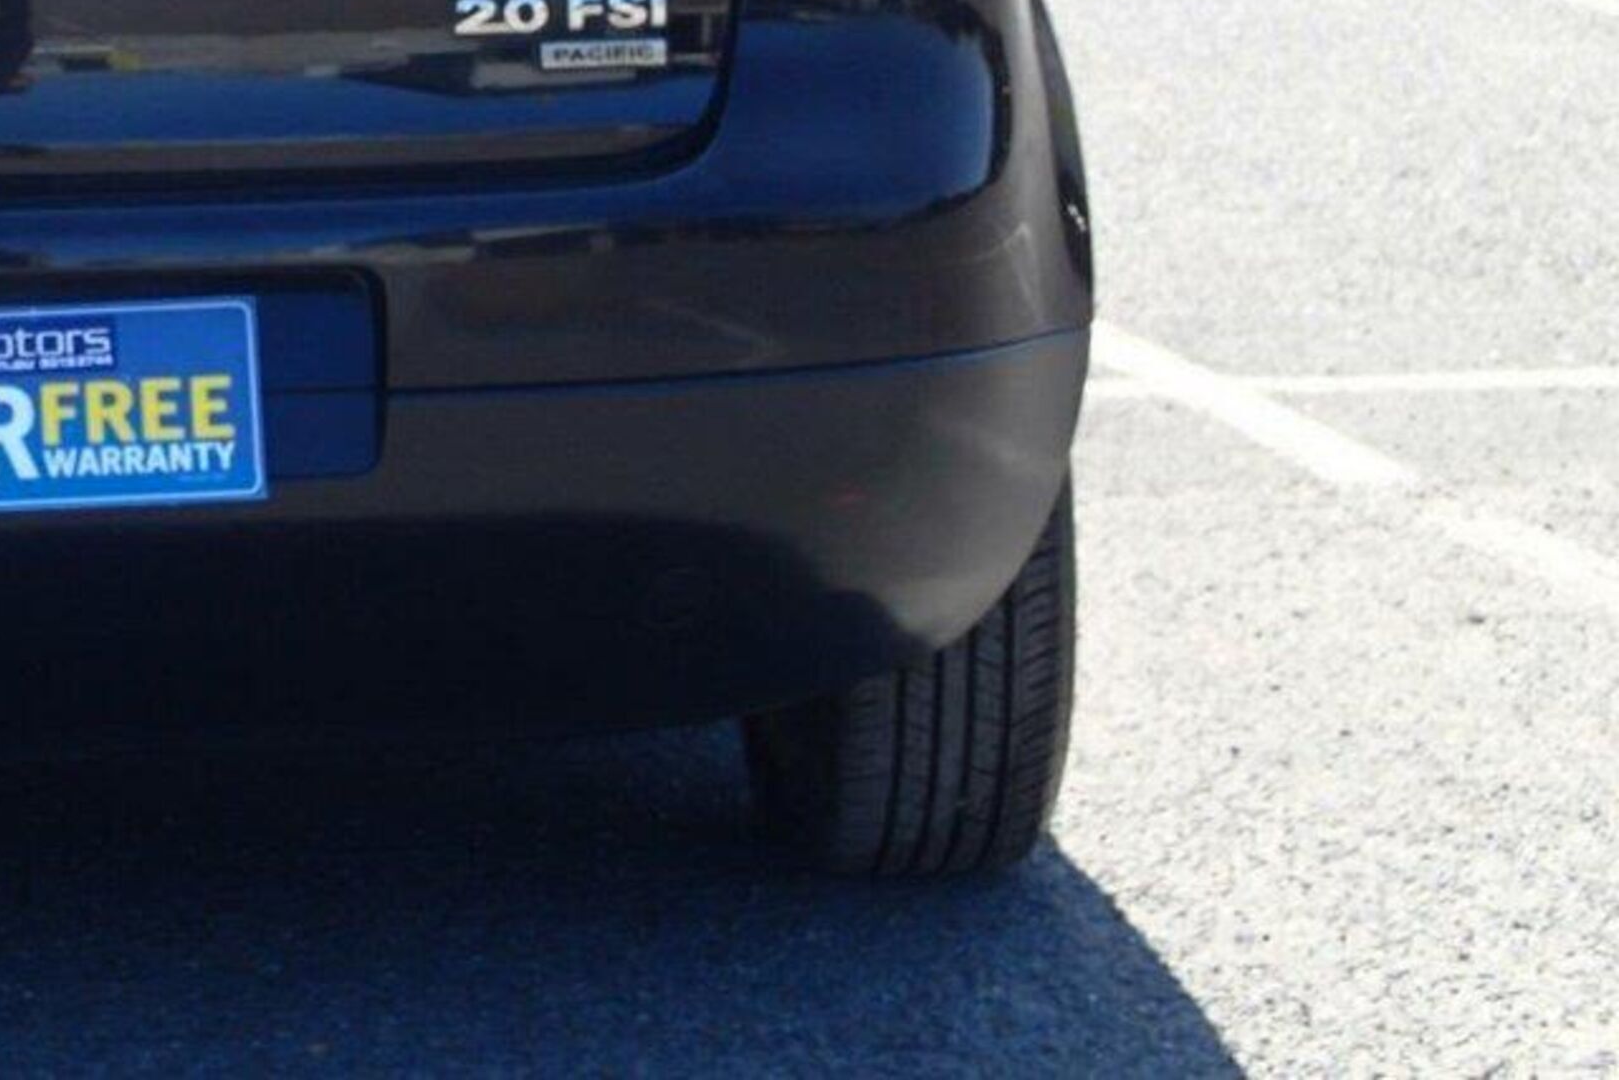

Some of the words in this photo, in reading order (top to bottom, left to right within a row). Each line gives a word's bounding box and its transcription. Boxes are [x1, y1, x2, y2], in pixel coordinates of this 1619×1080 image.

[551, 44, 657, 63] PACIFIC
[40, 374, 236, 446] FREE
[42, 440, 236, 479] WARRANTY
